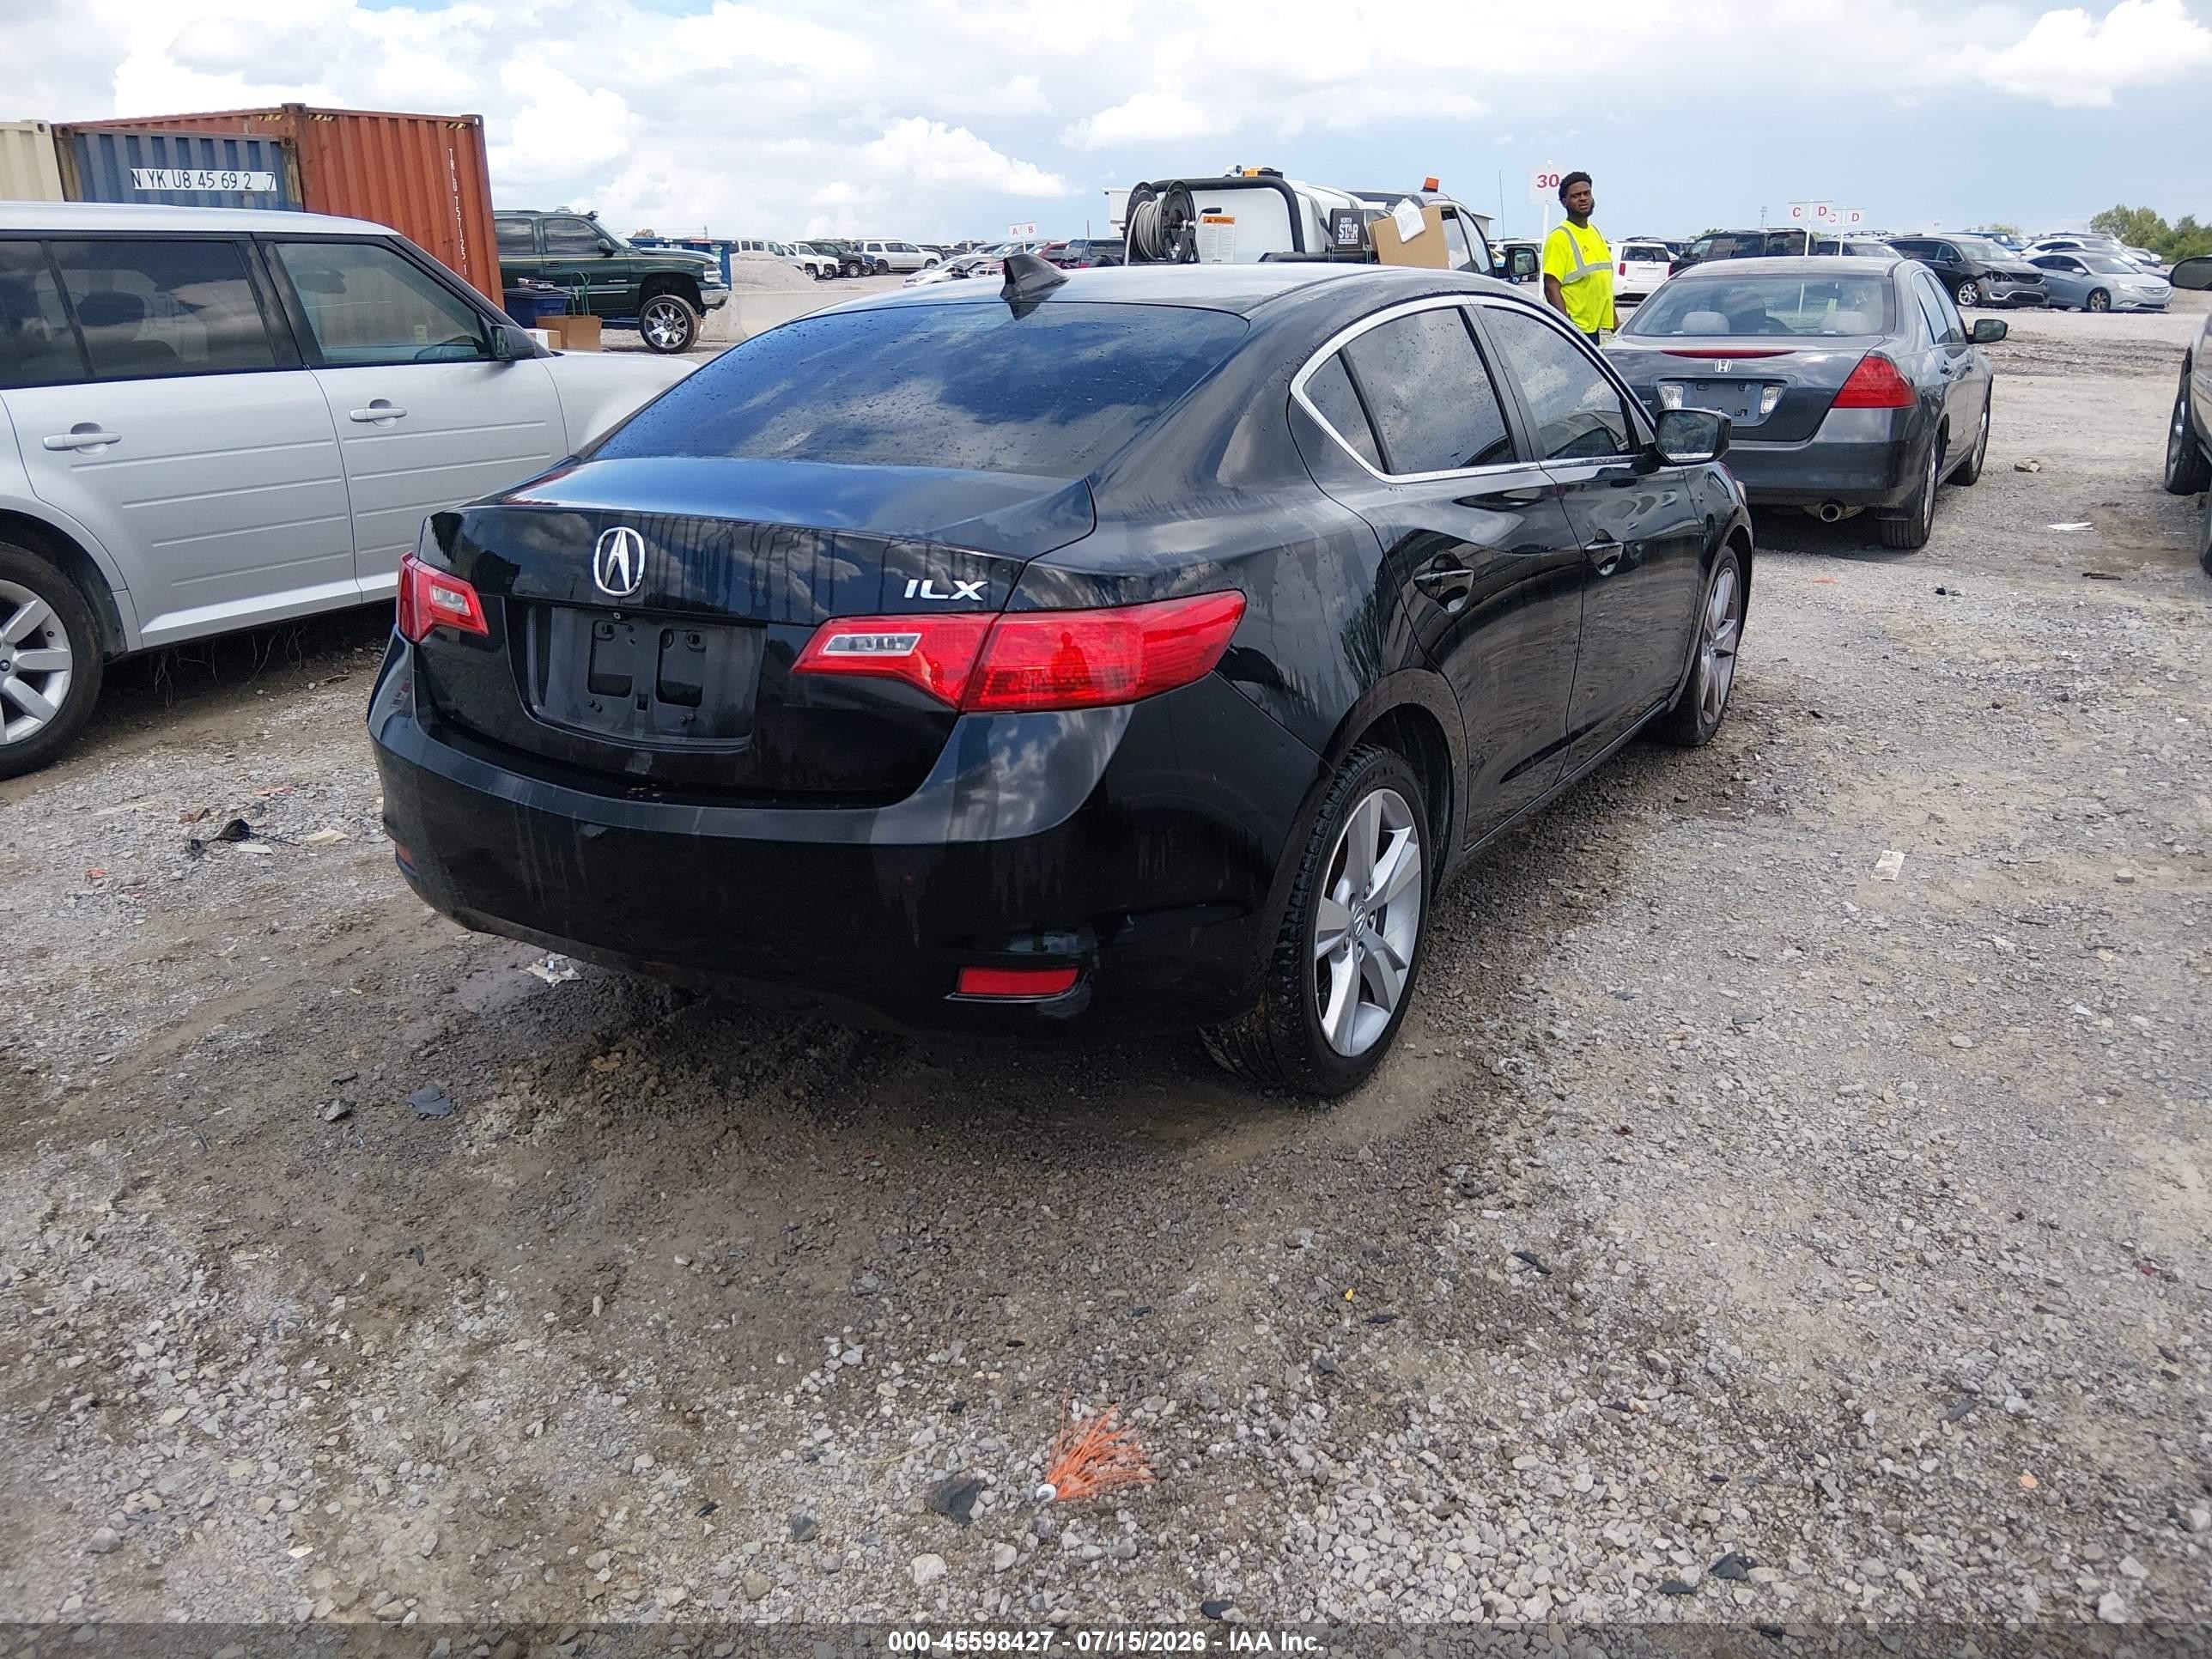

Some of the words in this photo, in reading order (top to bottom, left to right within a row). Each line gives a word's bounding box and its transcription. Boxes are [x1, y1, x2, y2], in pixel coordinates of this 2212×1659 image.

[1536, 173, 1560, 189] 30
[1792, 207, 1802, 218] C
[1818, 206, 1826, 216] D
[1851, 213, 1859, 222] D
[1339, 223, 1358, 239] STAR
[903, 579, 988, 601] ILX
